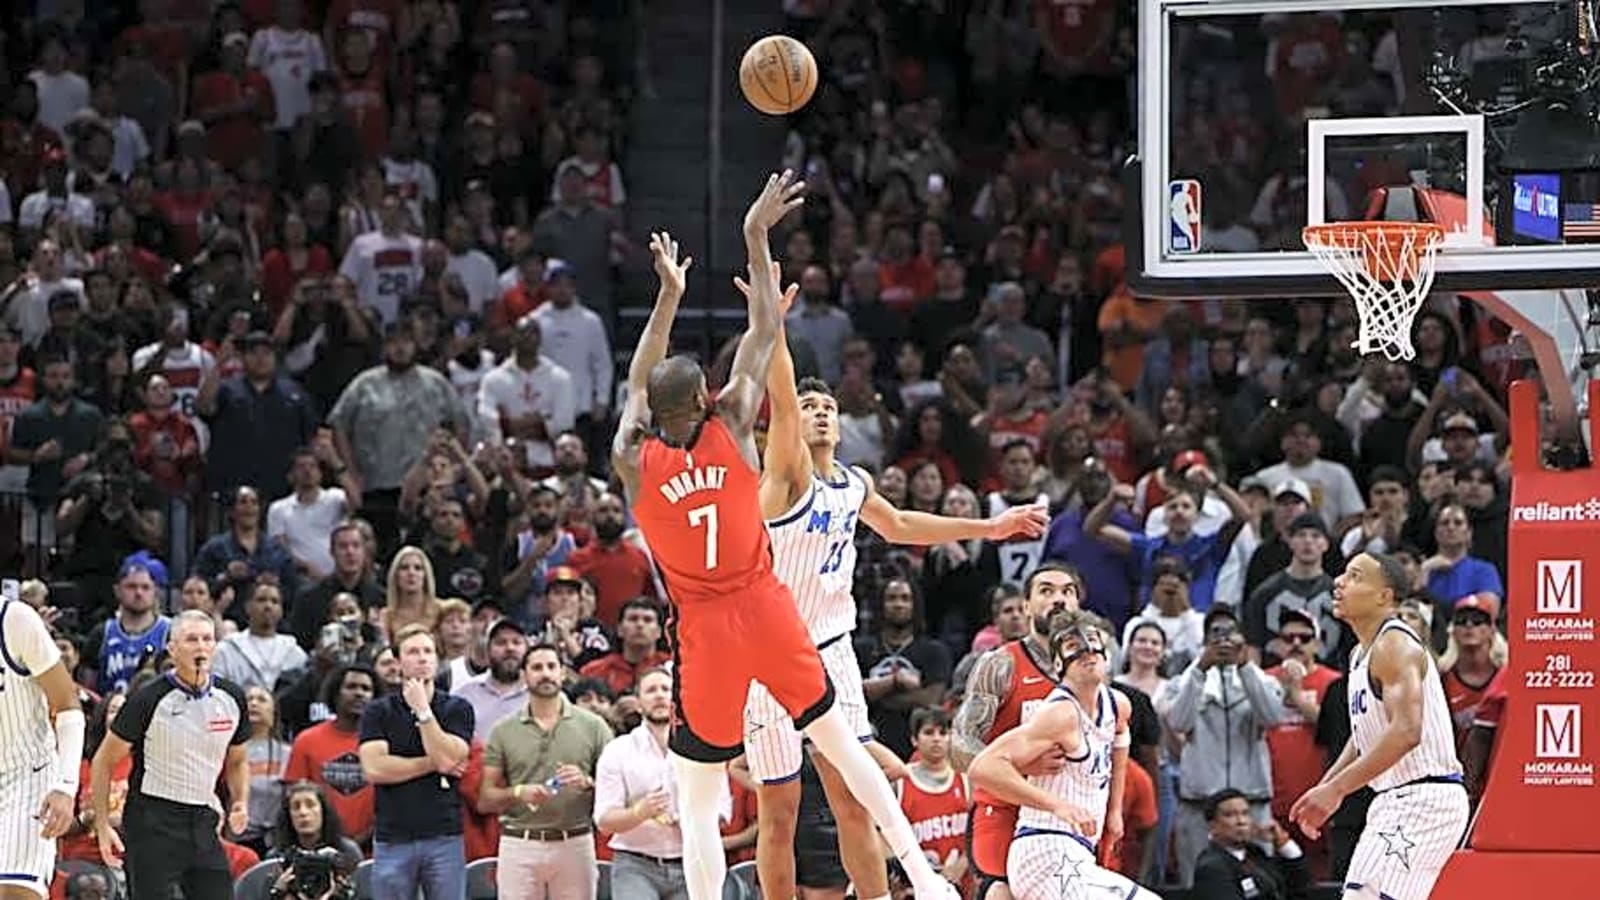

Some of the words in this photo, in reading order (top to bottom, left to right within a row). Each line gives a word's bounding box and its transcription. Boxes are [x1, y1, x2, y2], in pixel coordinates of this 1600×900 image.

[660, 465, 728, 504] DURANT
[1513, 501, 1585, 522] reliant
[687, 503, 718, 571] 7
[1010, 552, 1029, 581] 7
[1543, 563, 1576, 610] M
[1525, 617, 1594, 630] MOKARAM
[1556, 631, 1594, 641] LAWYERS
[1545, 655, 1571, 671] 281
[1525, 671, 1594, 688] 222-2222
[1542, 708, 1575, 755] M
[1524, 762, 1594, 775] MOKARAM
